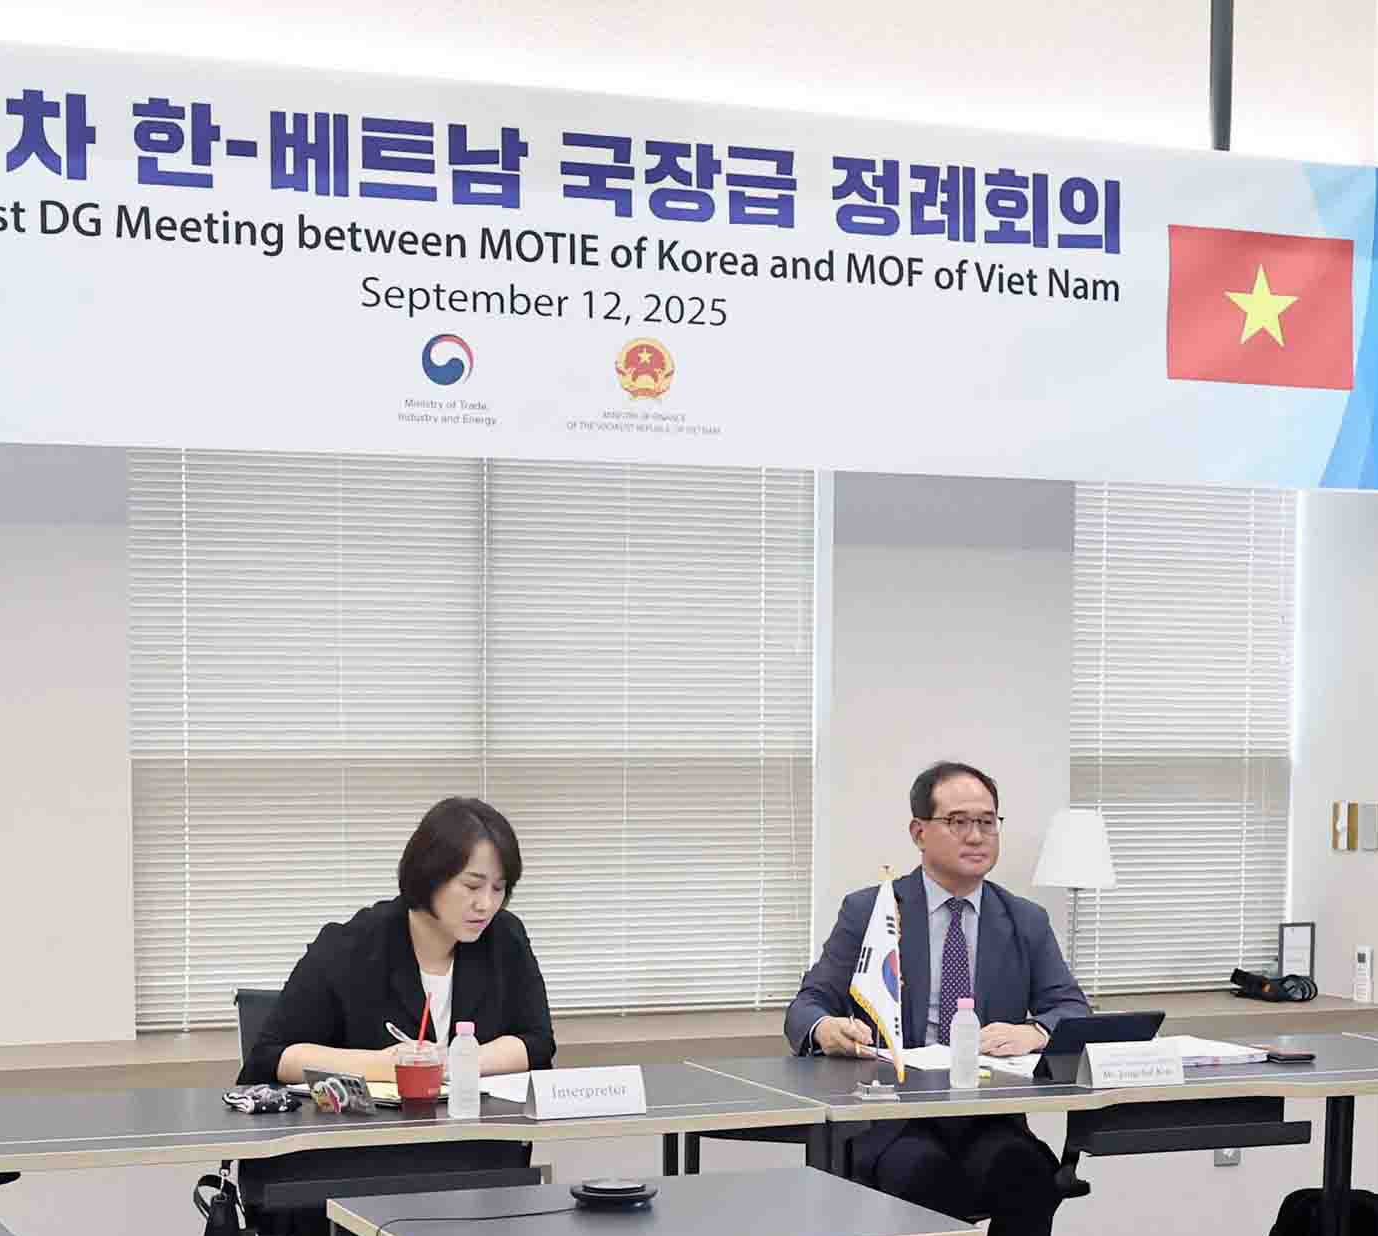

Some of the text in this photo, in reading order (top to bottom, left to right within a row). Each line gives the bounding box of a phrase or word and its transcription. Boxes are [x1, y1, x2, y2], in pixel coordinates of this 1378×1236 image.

[132, 97, 529, 209] 한-베트남
[559, 131, 798, 229] 국장급
[831, 155, 1121, 255] 정례회의
[40, 199, 102, 237] DG
[115, 204, 284, 257] Meeting
[298, 213, 467, 259] between
[479, 227, 599, 267] MOTIE
[610, 235, 649, 270] of
[658, 239, 759, 277] Korea
[769, 249, 834, 282] and
[846, 252, 924, 288] MOF
[934, 259, 969, 291] of
[974, 261, 1038, 297] Viet
[1048, 267, 1120, 303] Nam
[361, 276, 727, 327] September 12, 2025
[397, 412, 498, 426] Industry and Energy
[404, 398, 443, 411] Ministry
[446, 399, 456, 410] of
[551, 1083, 627, 1099] Interpreter
